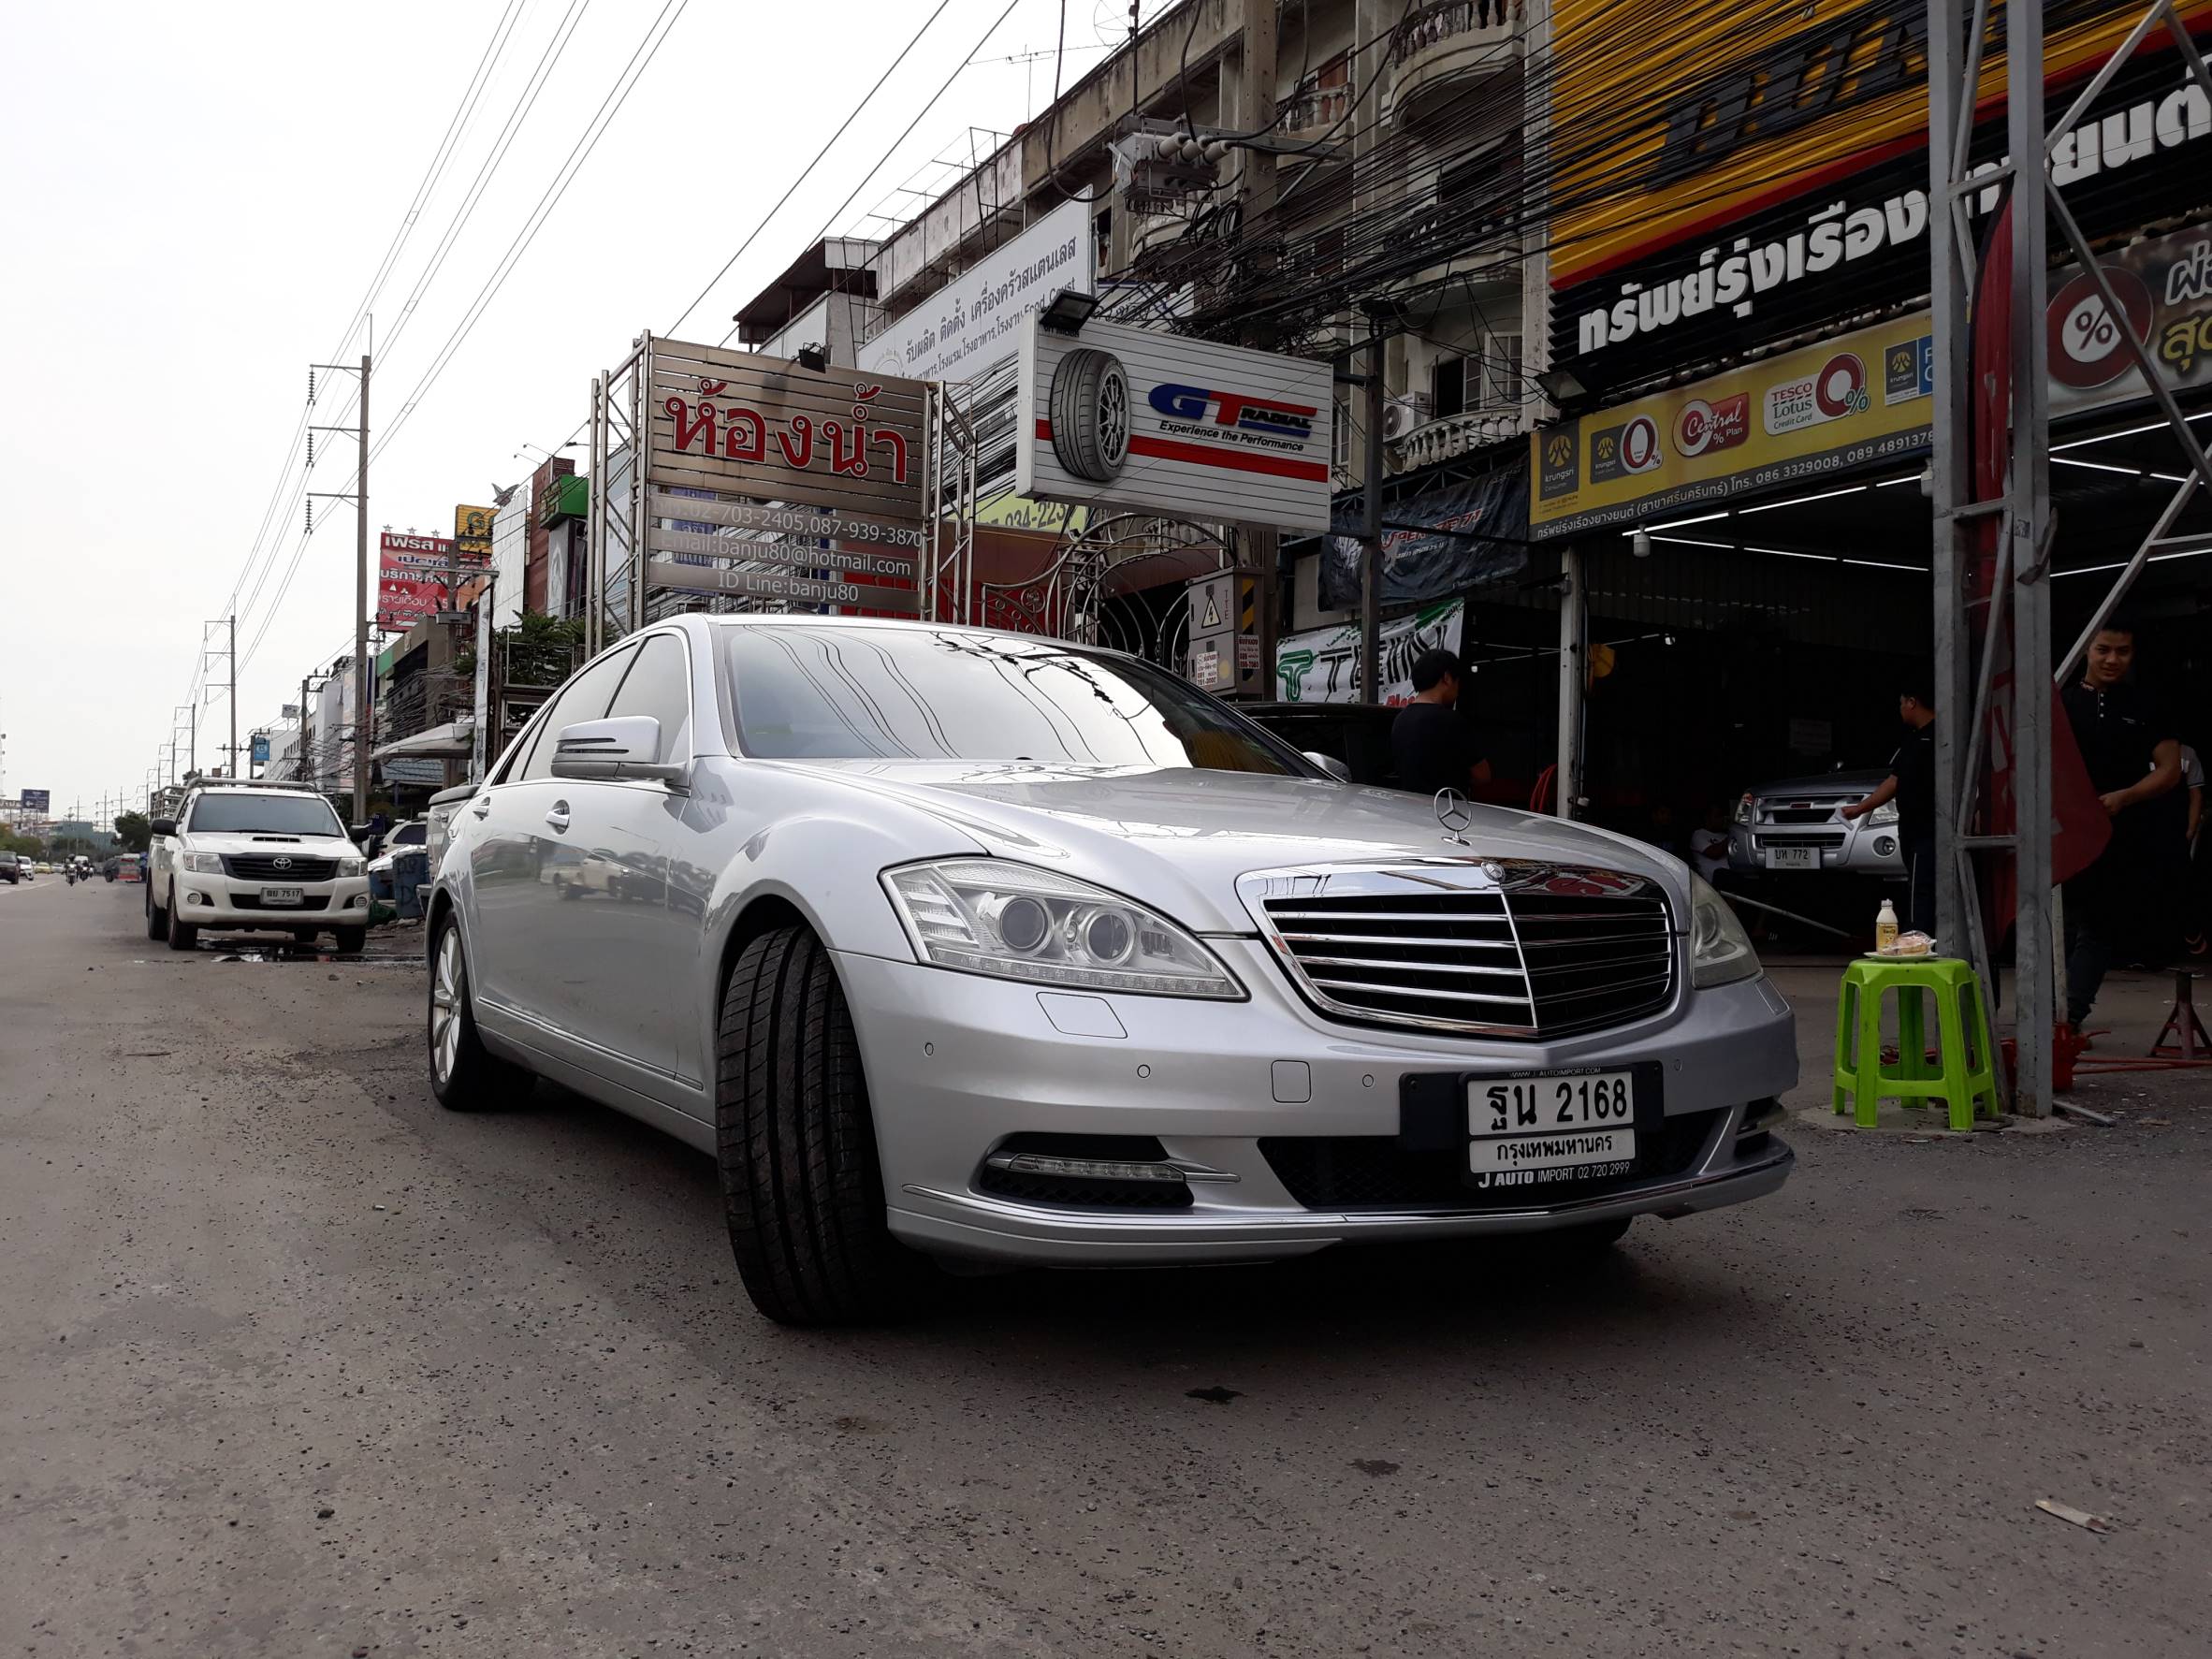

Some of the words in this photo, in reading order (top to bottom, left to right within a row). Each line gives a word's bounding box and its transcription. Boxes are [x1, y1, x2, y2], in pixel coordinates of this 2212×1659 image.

[970, 236, 1077, 323] เครื่องครัวสแตนเลส
[1771, 382, 1812, 403] TESCO
[1687, 400, 1742, 438] Central
[1773, 398, 1812, 420] Lotus
[1773, 417, 1795, 430] Credit
[1796, 414, 1812, 426] Card
[663, 378, 907, 484] ห้องน้ำ
[1159, 419, 1219, 438] Experience
[1221, 430, 1238, 443] the
[1240, 433, 1303, 452] Performance
[1726, 426, 1743, 438] Plan
[1545, 467, 1574, 484] krungsri
[1731, 476, 1753, 492] โทร.
[1756, 469, 1779, 484] 086
[1783, 456, 1843, 478] 3329008,
[1847, 445, 1873, 463] 089
[718, 571, 739, 589] ID
[749, 575, 859, 602] Line:banju80
[1486, 1084, 1537, 1131] ฐน
[1555, 1078, 1628, 1123] 2168
[1496, 1134, 1613, 1167] กรุงเทพมหานคร
[1477, 1171, 1492, 1189] J
[1494, 1170, 1535, 1187] AUTO
[1537, 1167, 1575, 1184] IMPORT
[1578, 1165, 1591, 1180] 02
[1591, 1163, 1608, 1179] 720
[1609, 1161, 1631, 1177] 2999
